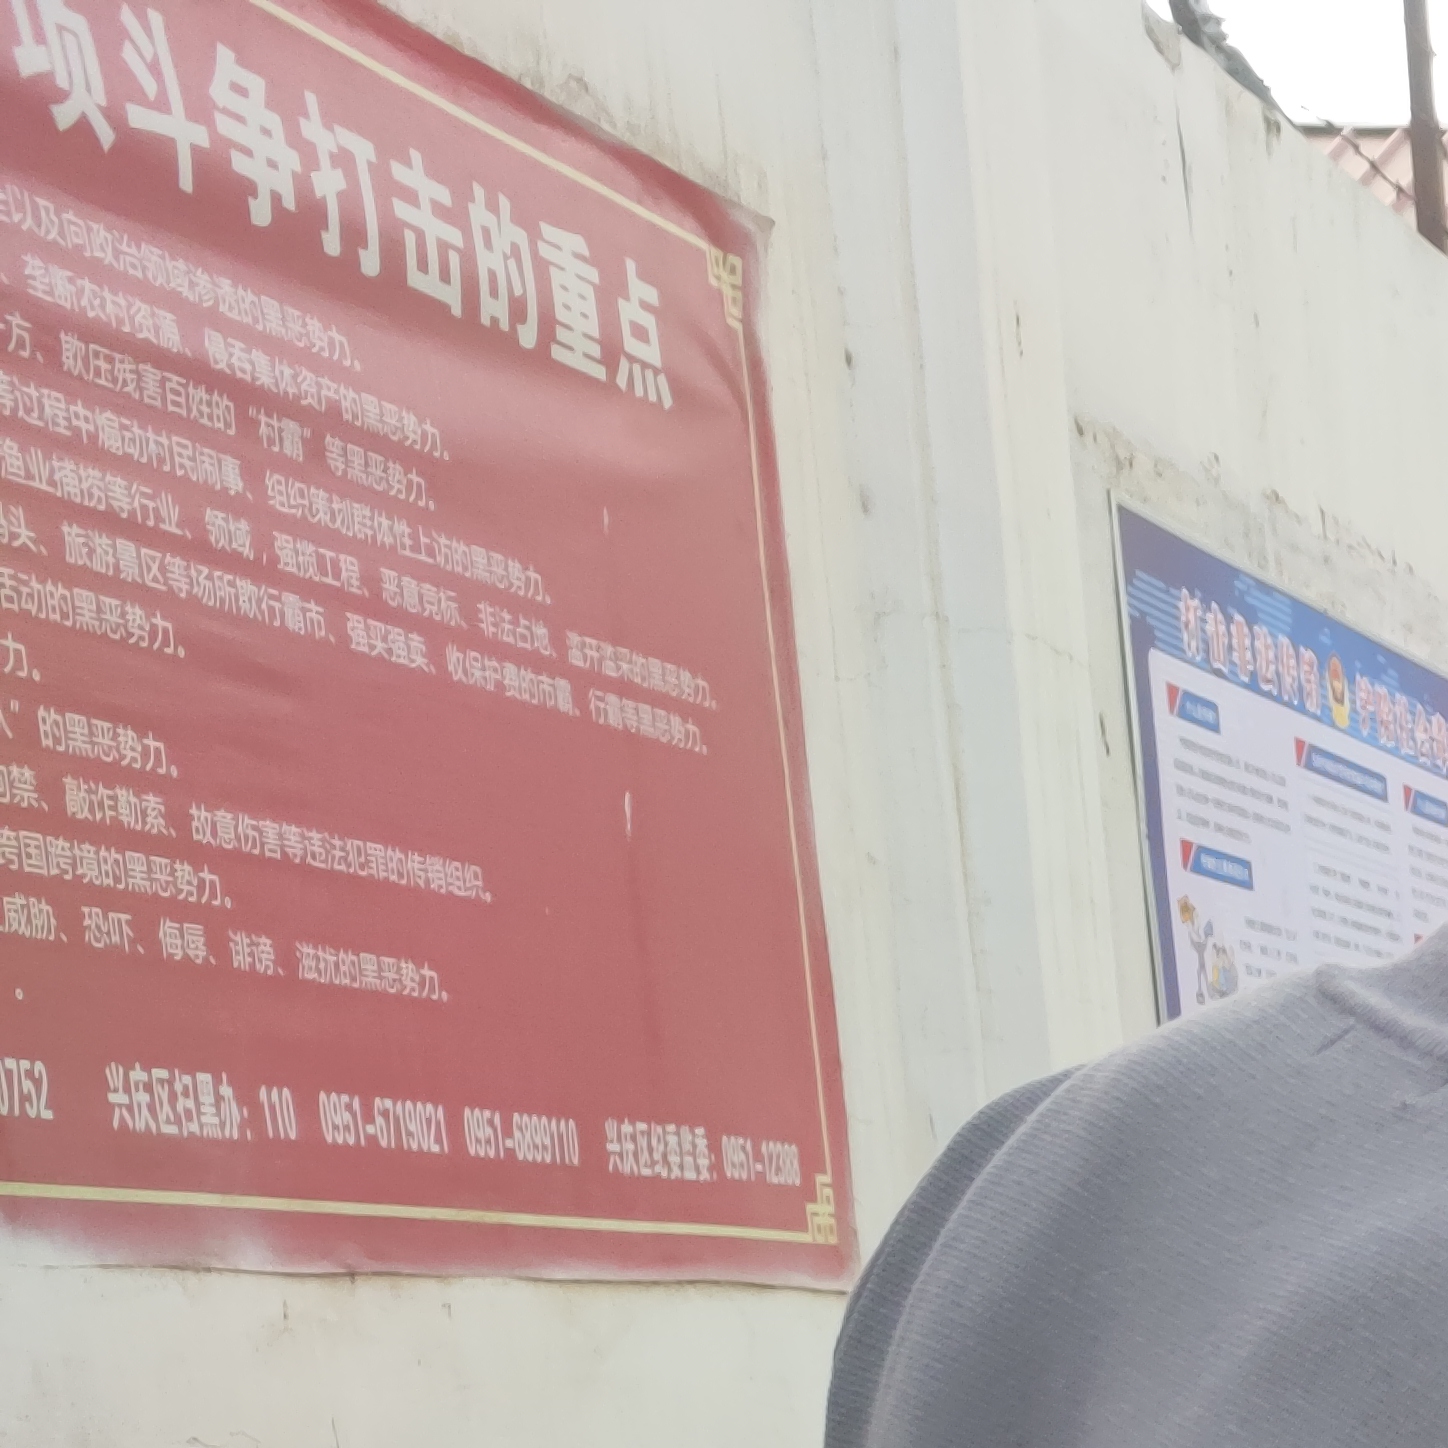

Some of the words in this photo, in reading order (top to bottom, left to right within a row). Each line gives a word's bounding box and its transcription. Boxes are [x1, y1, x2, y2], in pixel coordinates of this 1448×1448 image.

[0, 184, 362, 372] 以及向政治领域渗透的黑恶势力。
[10, 0, 673, 409] 项斗争打击的重点
[318, 1090, 449, 1154] 0951-6719021
[464, 1105, 580, 1167] 0951-6899110
